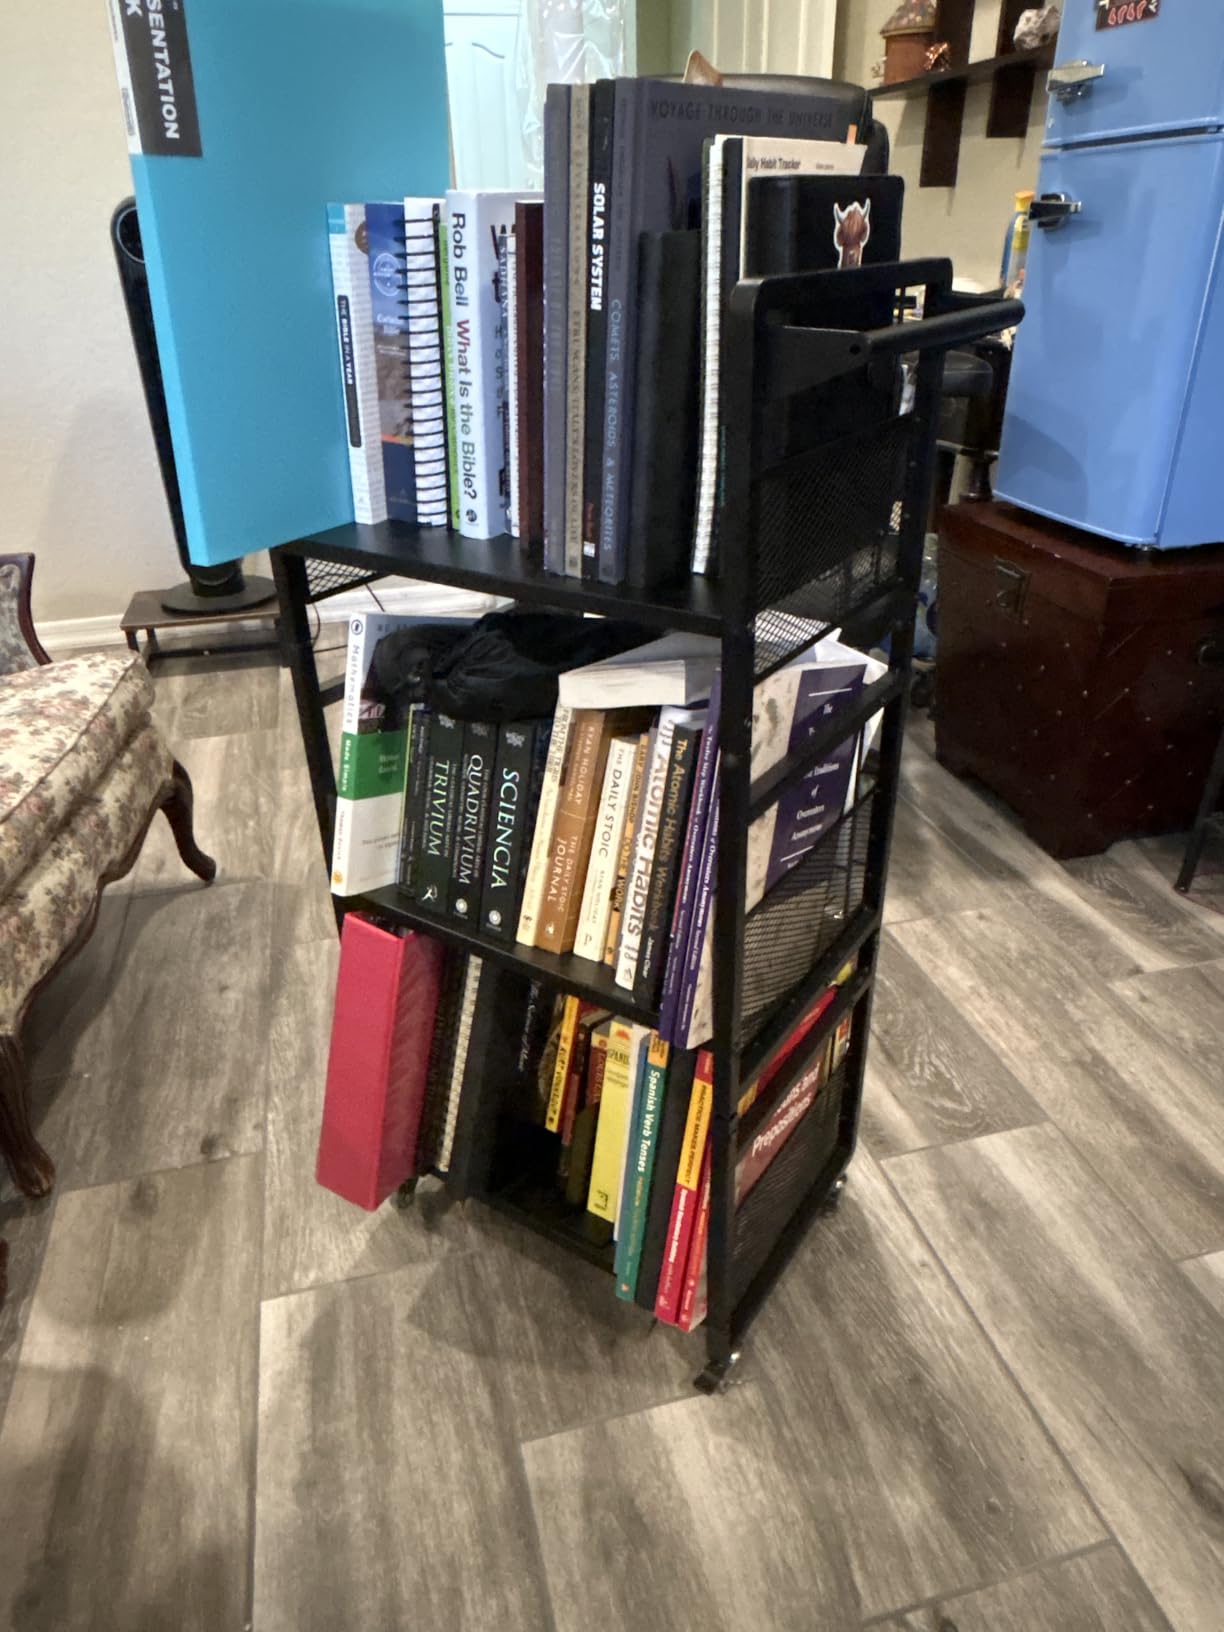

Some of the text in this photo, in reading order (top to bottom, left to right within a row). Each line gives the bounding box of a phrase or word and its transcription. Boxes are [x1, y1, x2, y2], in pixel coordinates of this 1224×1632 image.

[652, 101, 833, 128] VOYAGE THROUGH THE UNIVERSE
[760, 157, 777, 170] Habit
[778, 157, 801, 171] Tracker
[590, 182, 606, 311] SOLAR SYSTEM
[499, 247, 508, 319] SADHANA
[342, 318, 350, 343] BIBLE
[344, 344, 351, 354] IN
[451, 213, 477, 499] Rob Bell What Is the Bible?
[346, 362, 354, 385] YEAR
[602, 472, 616, 552] METEORITES
[345, 643, 361, 725] Mathematics
[344, 739, 352, 761] Made
[583, 726, 596, 755] RYAN
[615, 748, 625, 765] THE
[637, 744, 646, 768] GARY
[704, 735, 714, 760] Twelve
[342, 763, 351, 792] Simple
[574, 758, 591, 806] HOLIDAY
[633, 770, 643, 792] JOHN
[699, 762, 710, 778] Step
[605, 768, 622, 812] DAILY
[642, 753, 670, 850] Atomic
[695, 779, 708, 816] Workbook
[427, 760, 450, 856] TRIVIUM
[458, 754, 484, 885] QUADRIVIUM
[628, 793, 640, 825] BISHOP
[490, 767, 521, 889] SCIENCIA
[569, 835, 578, 854] THE
[598, 814, 615, 859] STOIC
[687, 824, 701, 862] Overeaters
[547, 838, 567, 904] JOURNAL
[563, 858, 574, 885] DAILY
[642, 739, 688, 979] The Atomic Habits Workbook James Clear
[703, 845, 717, 884] Overeaters
[557, 887, 570, 914] STOIC
[613, 877, 626, 911] WORK
[627, 856, 653, 937] Habits
[682, 863, 695, 905] Anonymous
[697, 884, 710, 928] Anonymous
[692, 929, 703, 949] Second
[690, 949, 700, 971] Edition
[645, 1069, 661, 1111] Spanish
[800, 1061, 820, 1088] and
[642, 1113, 655, 1137] Verb
[685, 1084, 707, 1185] PRACTICE MAKES PERFECT
[752, 1092, 812, 1158] Prepositions
[636, 1139, 651, 1173] Tenses
